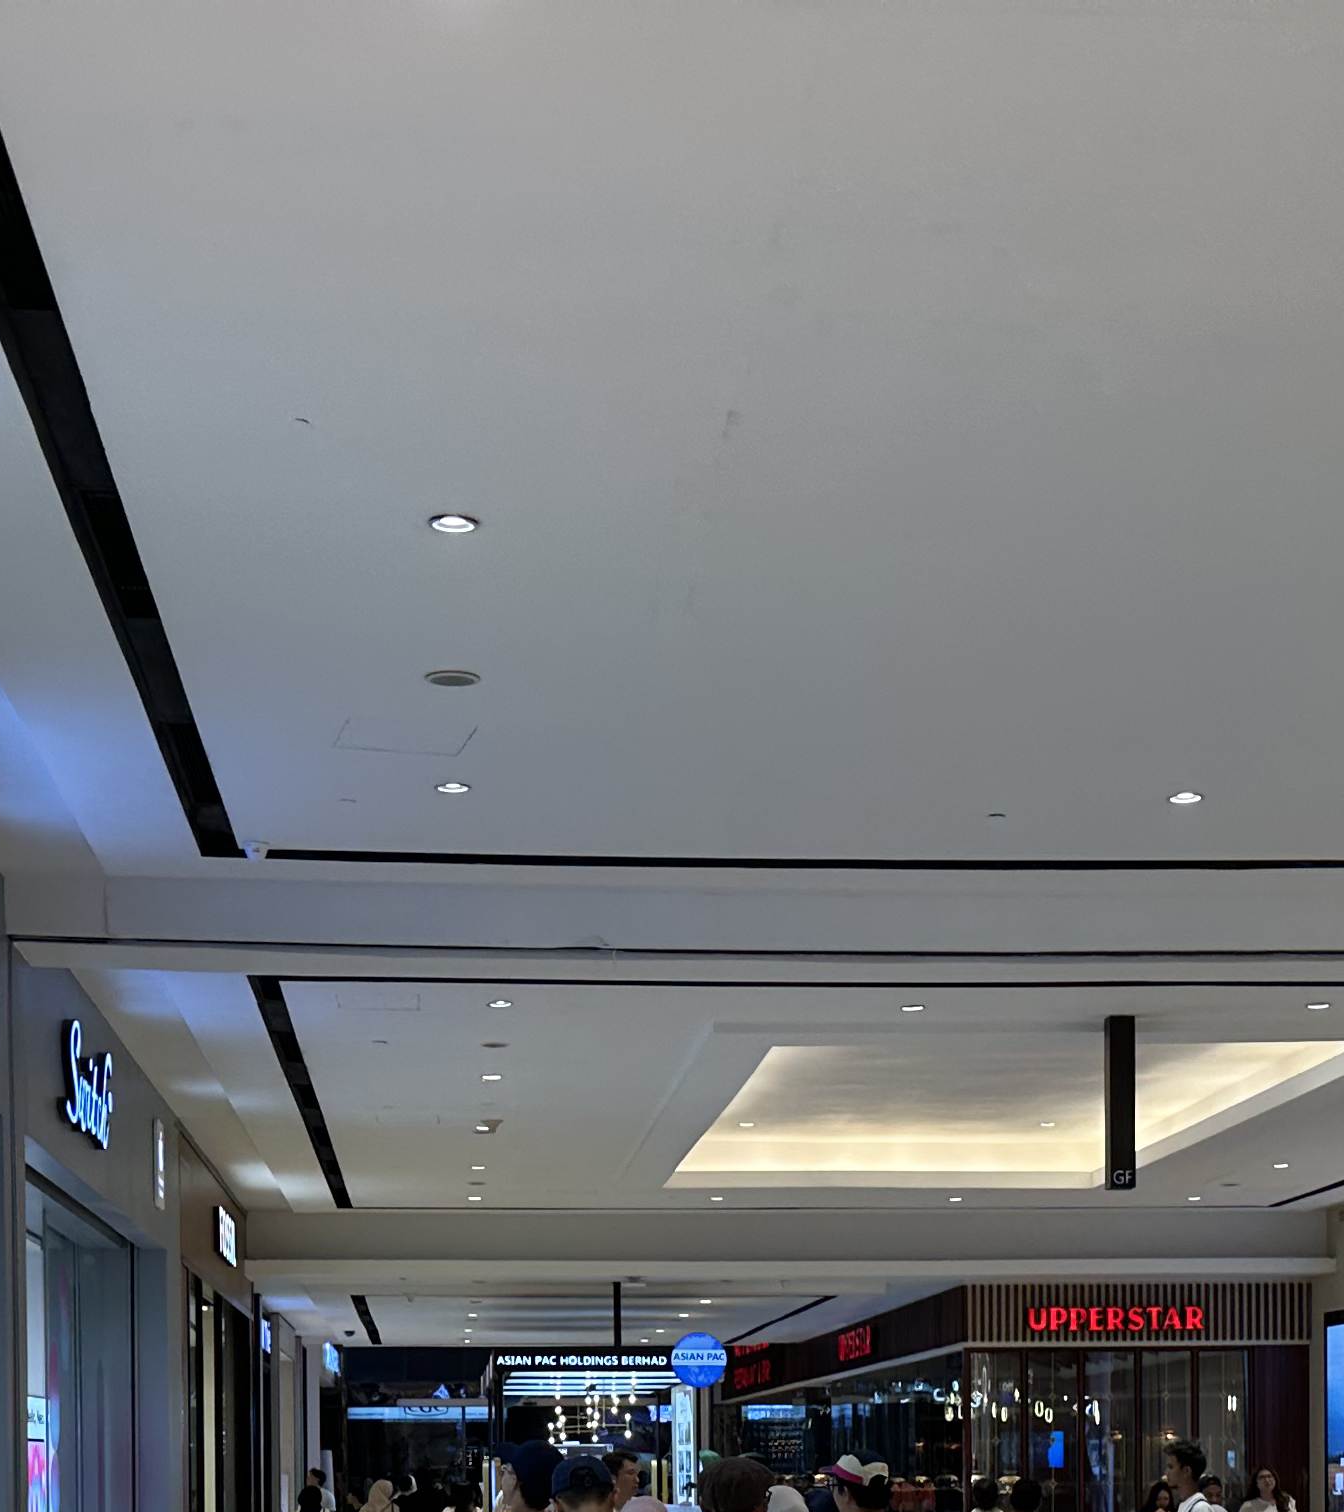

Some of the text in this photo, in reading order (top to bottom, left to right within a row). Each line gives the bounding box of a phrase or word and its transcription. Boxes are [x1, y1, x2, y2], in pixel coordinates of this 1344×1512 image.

[65, 1019, 113, 1150] Switch
[1112, 1169, 1133, 1185] GF
[1027, 1306, 1205, 1332] UPPERSTAR
[496, 1355, 668, 1367] ASIAN PAC HOLDINGS BERHAD
[673, 1351, 725, 1362] ASIAN PAC
